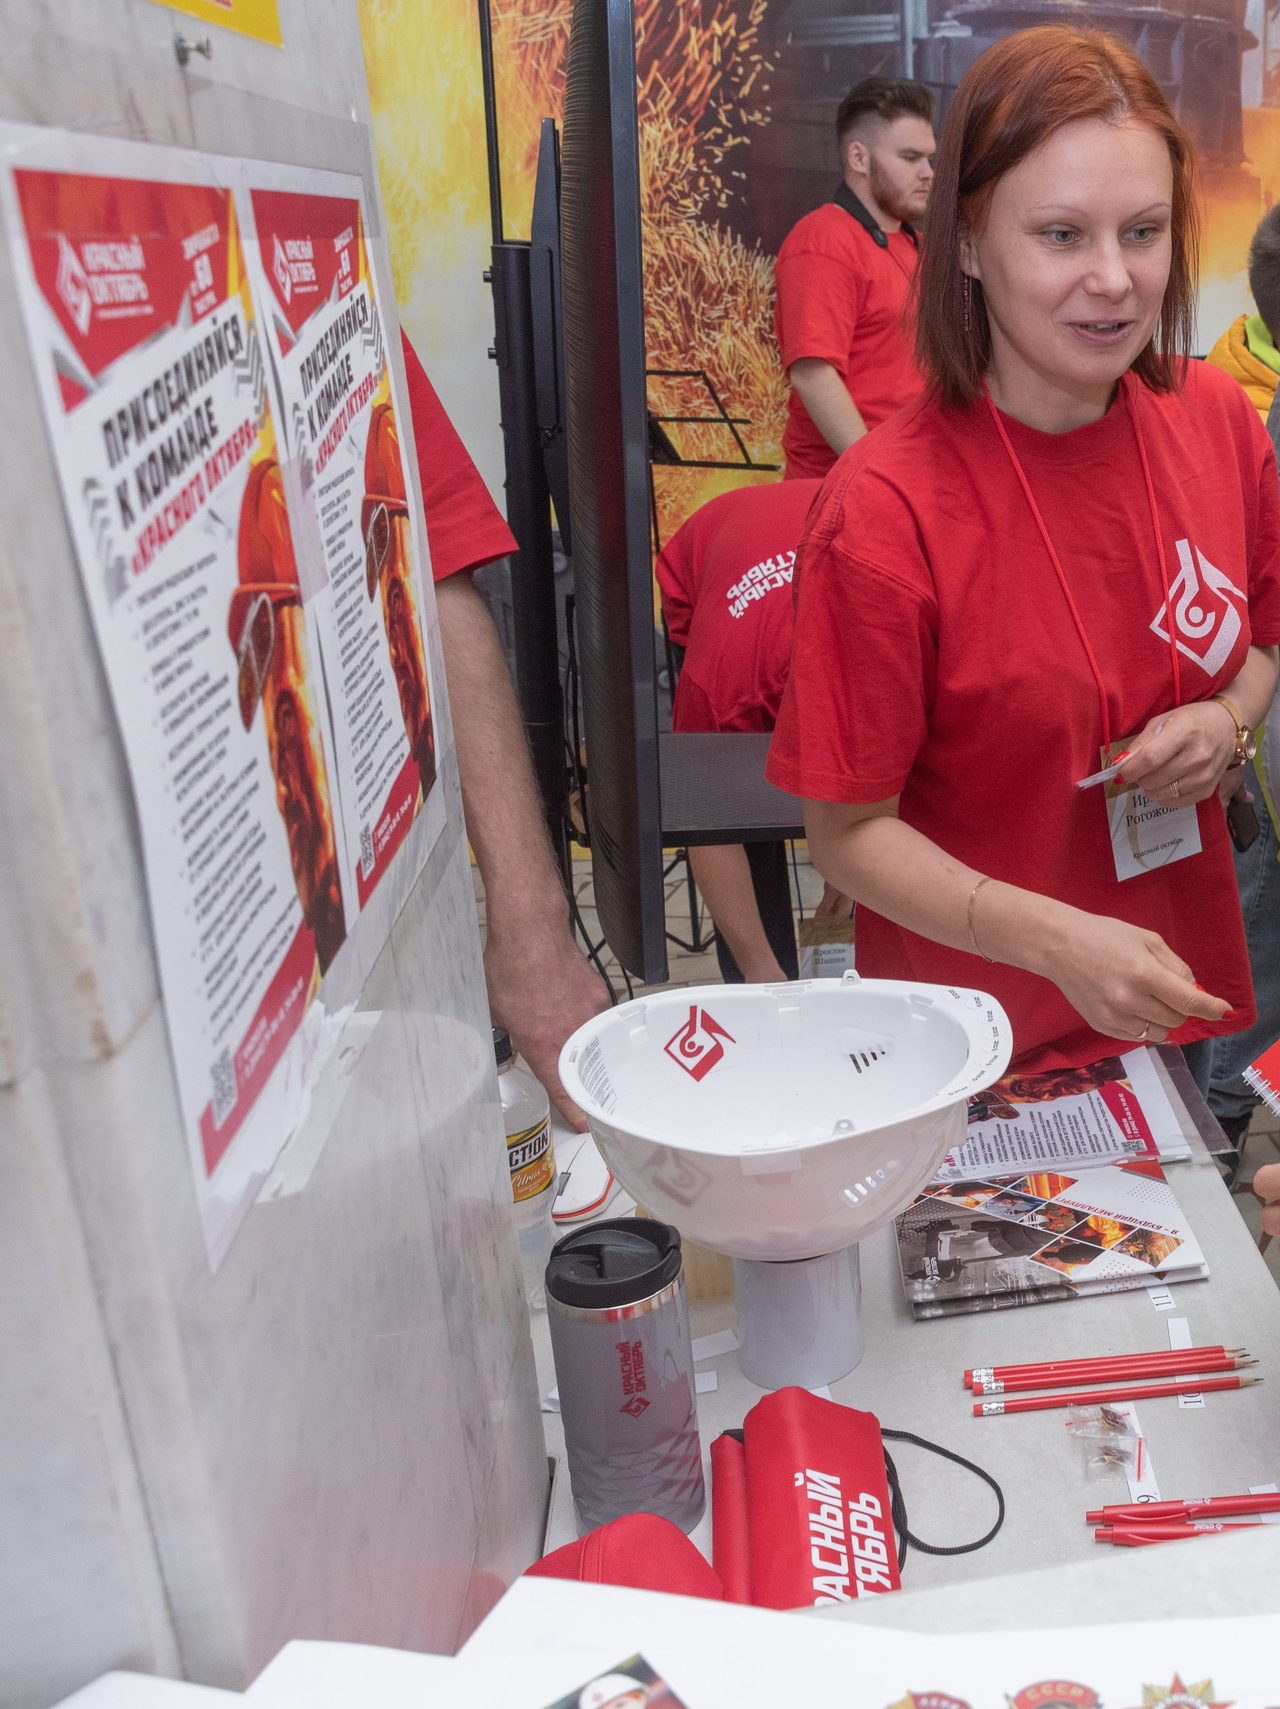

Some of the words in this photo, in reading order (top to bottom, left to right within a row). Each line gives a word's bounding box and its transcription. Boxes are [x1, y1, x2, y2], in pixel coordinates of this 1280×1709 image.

[299, 292, 369, 399] ПРИСОЕДИНЯЙСЯ
[103, 314, 243, 470] ПРИСОЕДИНЯЙСЯ
[307, 404, 318, 442] К
[315, 352, 354, 432] КОМАНДЕ
[315, 405, 348, 475] «КРАСНОГО
[345, 370, 379, 425] ОКТЯБРЯ»
[115, 477, 136, 532] К
[134, 395, 219, 512] КОМАНДЕ
[726, 550, 796, 600] ТЯБРЬ
[728, 564, 794, 619] АСНЫЙ
[1125, 805, 1183, 828] Рогожо
[1133, 846, 1160, 860] Красный
[1160, 837, 1184, 850] октябрь
[509, 1128, 548, 1168] CT!ON
[1114, 1213, 1162, 1231] БУДУЩИЙ
[1152, 1294, 1172, 1307] 11
[616, 1341, 635, 1396] КРАСНЫЙ
[631, 1340, 647, 1393] ОКТЯБРЬ
[794, 1468, 851, 1608] АСНЫЙ
[1025, 1683, 1084, 1701] СССР
